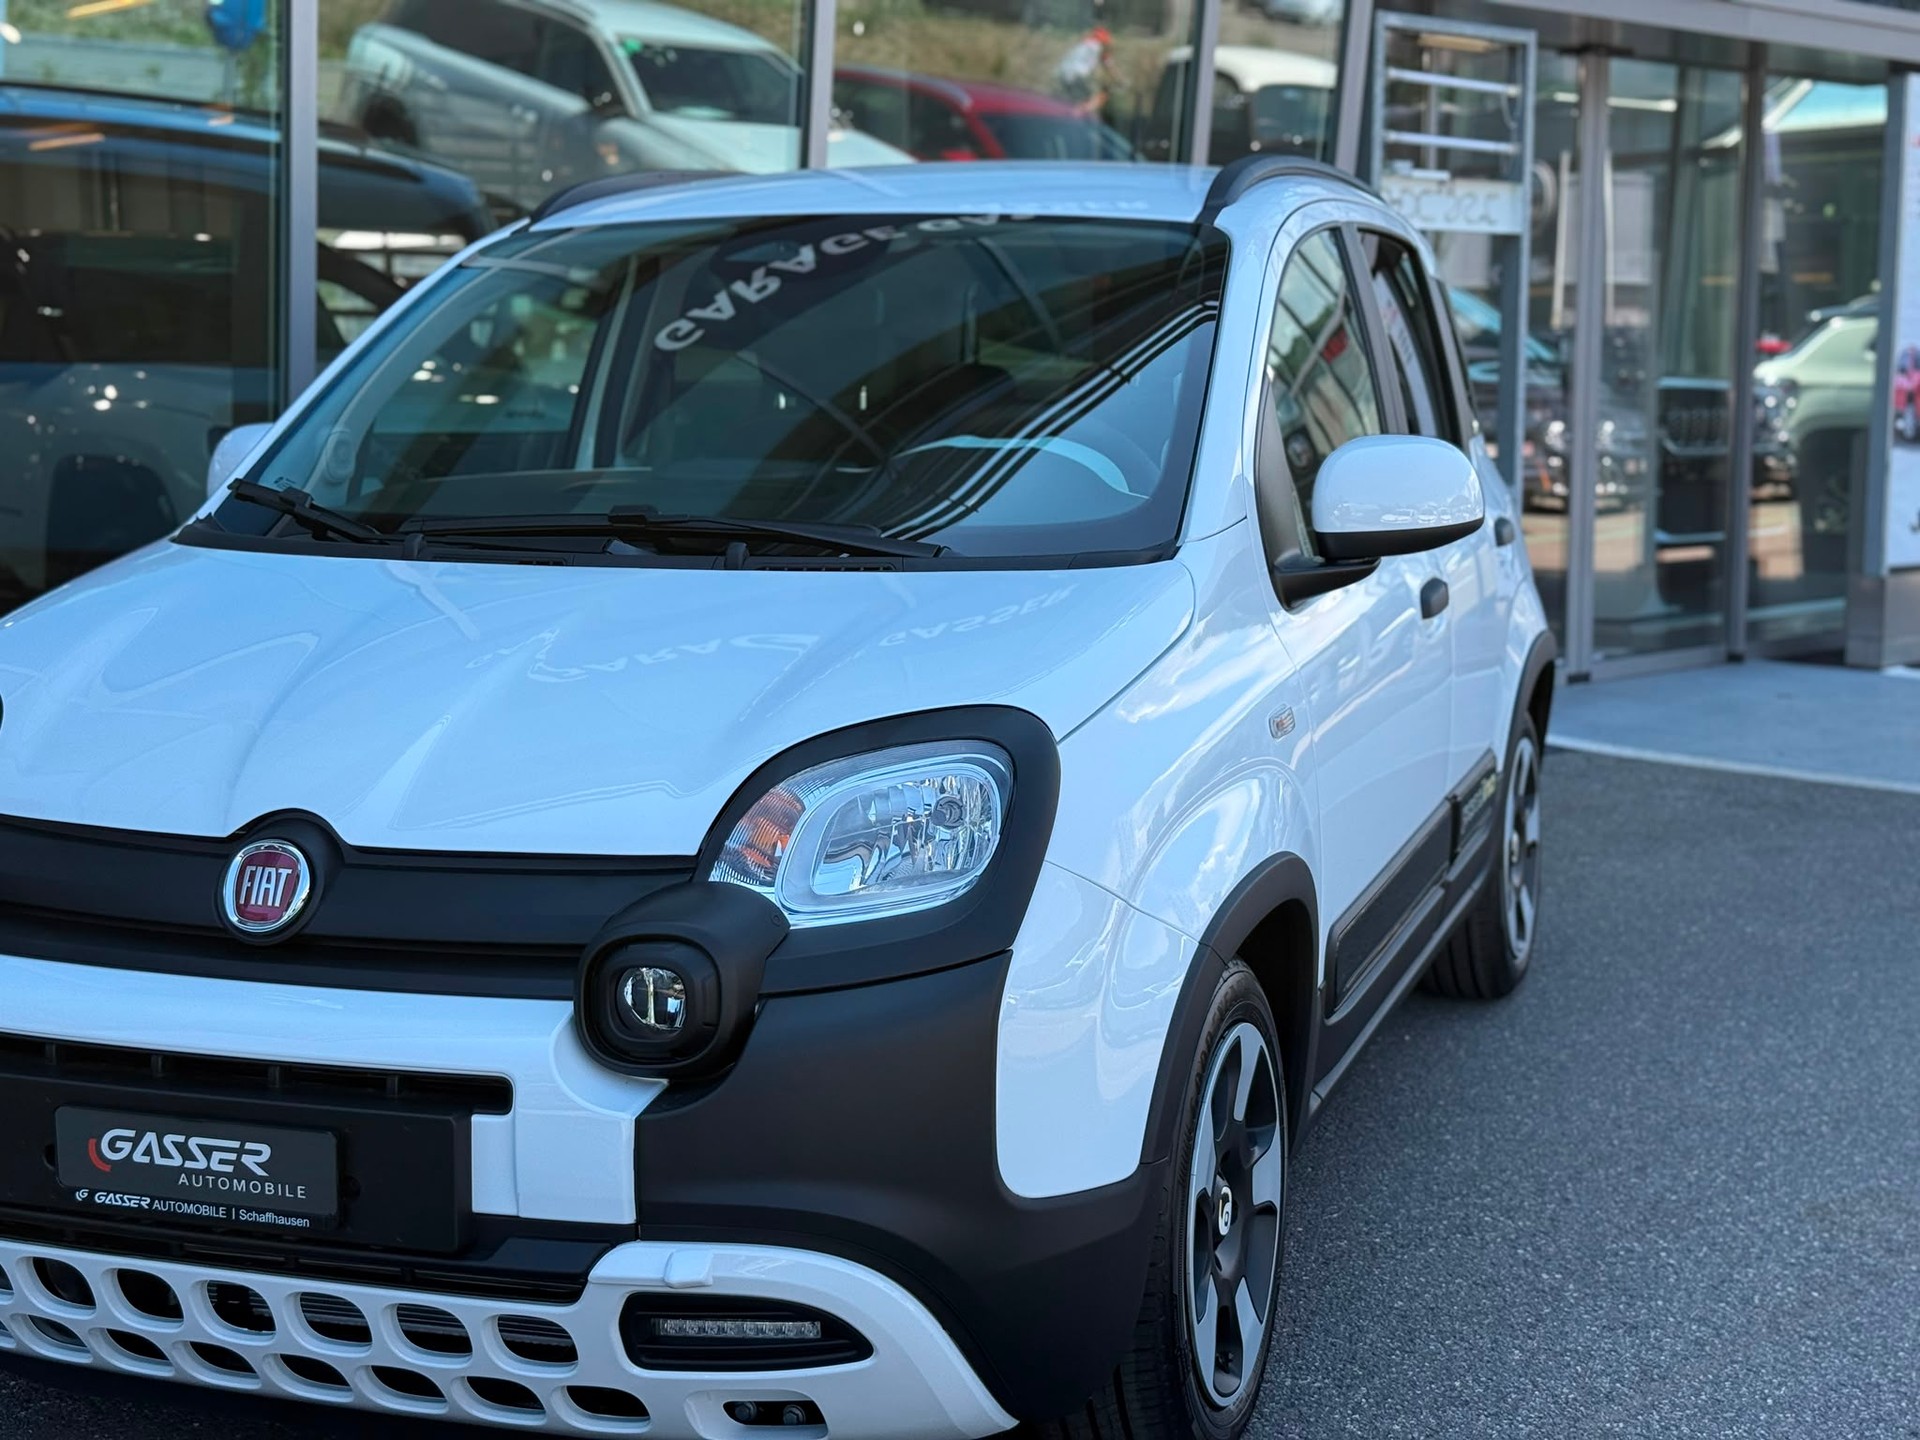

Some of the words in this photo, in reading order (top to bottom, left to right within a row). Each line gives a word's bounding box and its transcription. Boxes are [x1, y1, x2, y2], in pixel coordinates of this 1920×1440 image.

[239, 865, 293, 908] FIAT
[101, 1128, 272, 1177] GASSER
[178, 1173, 306, 1199] AUTOMOBILE
[94, 1192, 151, 1209] GASSER
[152, 1200, 227, 1218] AUTOMOBILE
[239, 1209, 310, 1227] Schaffhausen
